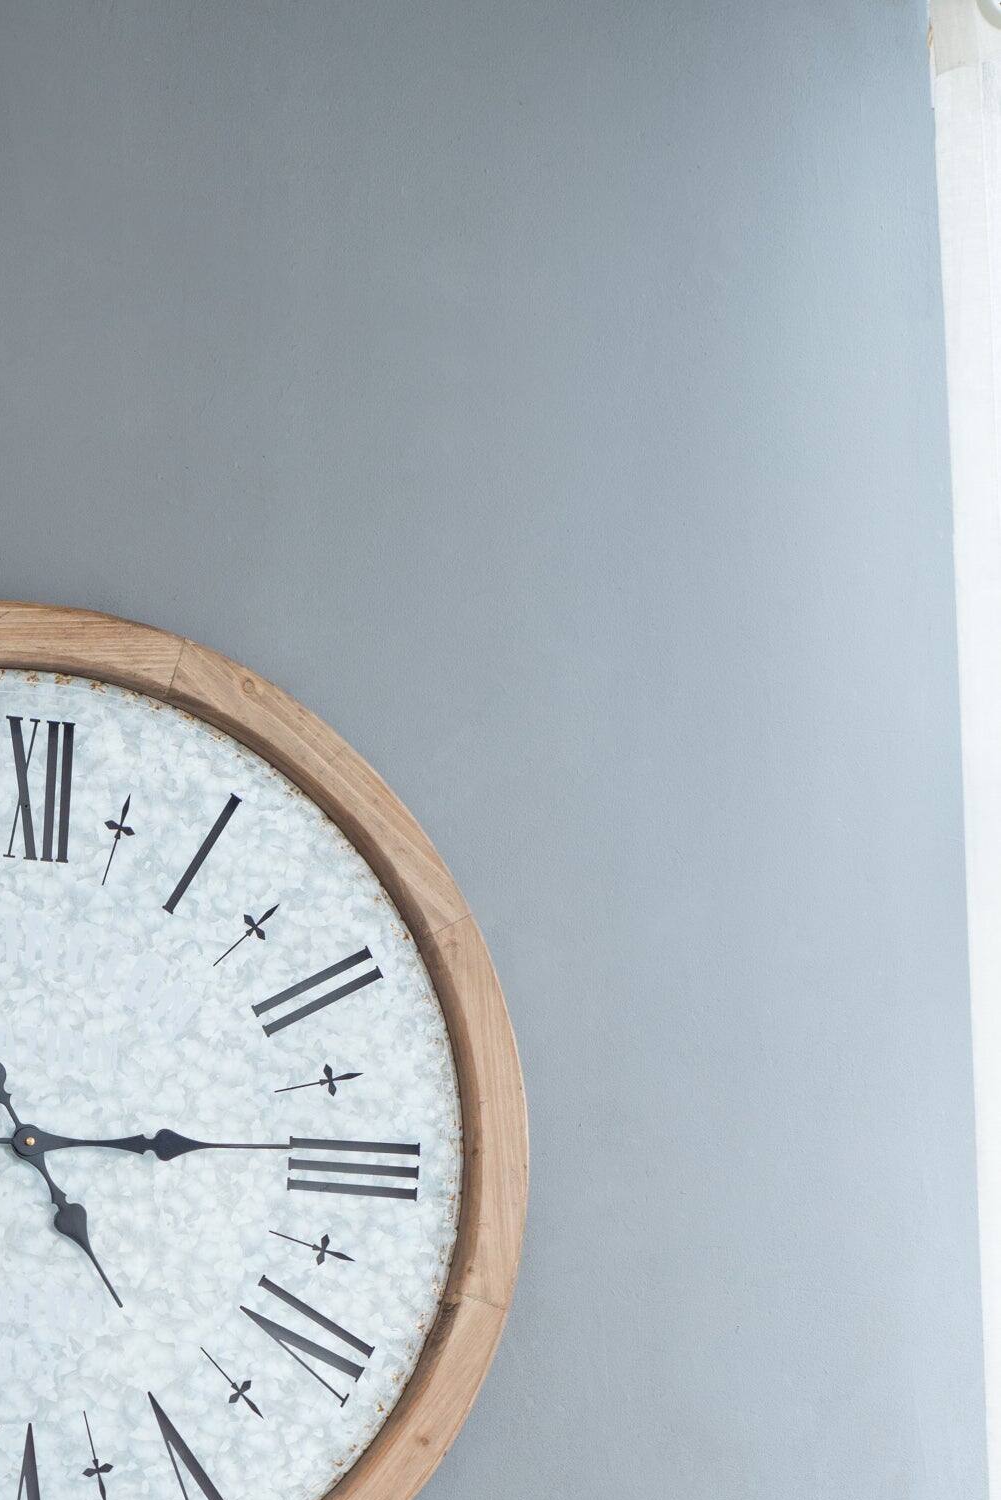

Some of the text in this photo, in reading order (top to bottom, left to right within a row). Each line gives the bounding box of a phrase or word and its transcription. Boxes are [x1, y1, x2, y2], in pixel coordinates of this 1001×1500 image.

[2, 715, 76, 864] XII
[162, 793, 242, 914] I
[251, 945, 384, 1038] II
[287, 1135, 421, 1202] III
[239, 1275, 375, 1407] IV
